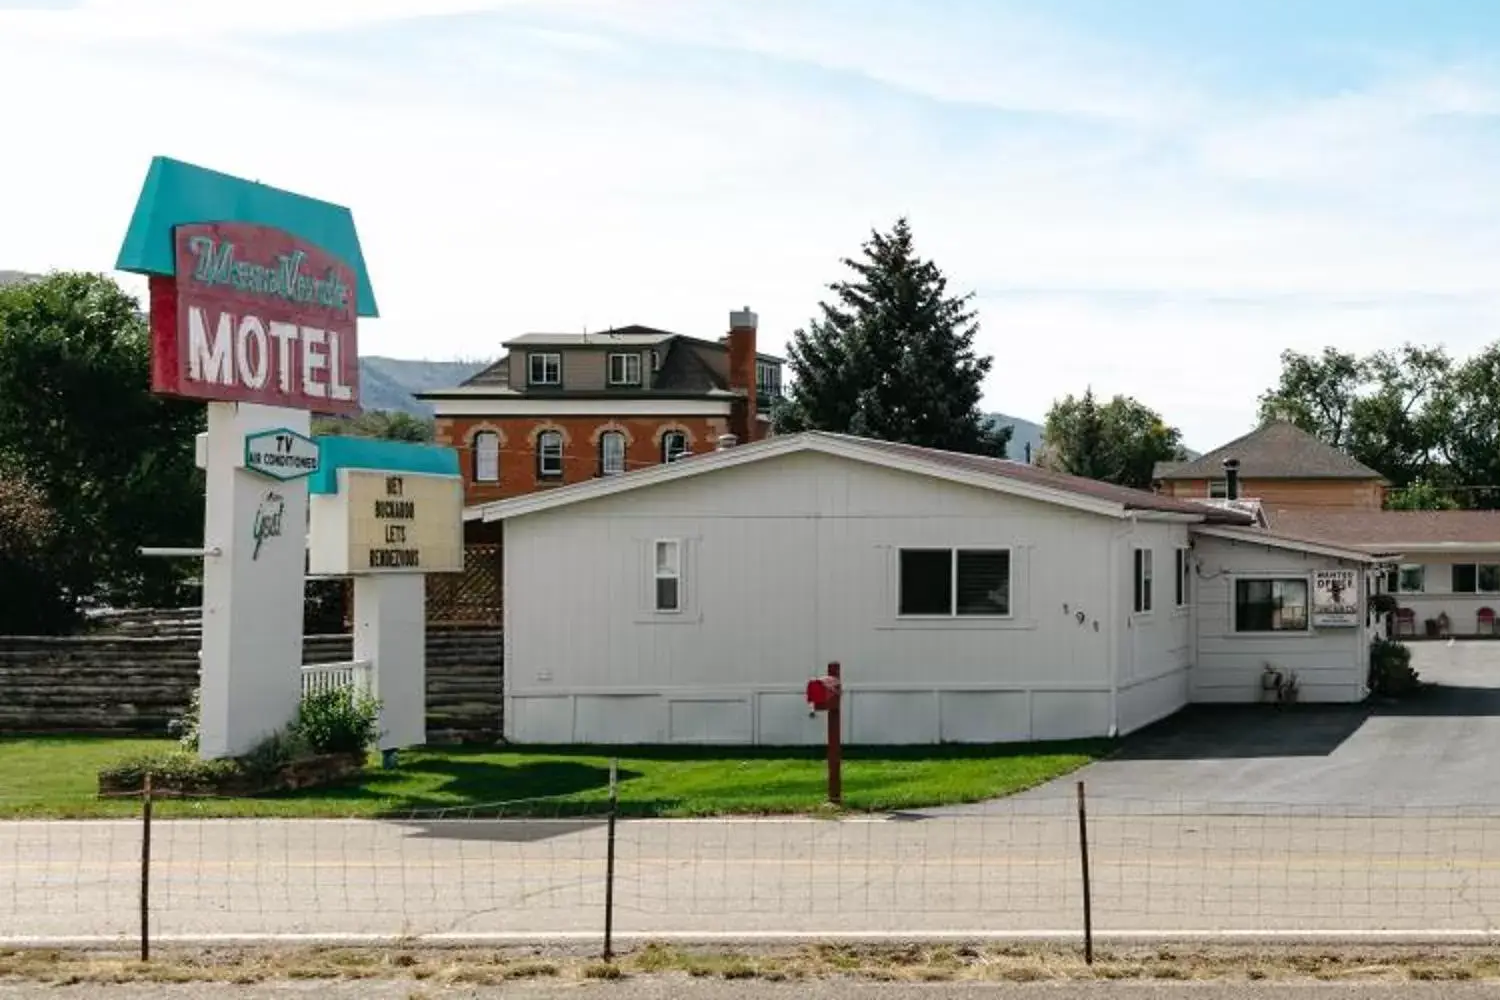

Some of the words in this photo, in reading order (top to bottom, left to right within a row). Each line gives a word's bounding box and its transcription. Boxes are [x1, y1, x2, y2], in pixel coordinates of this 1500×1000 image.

[187, 305, 352, 400] MOTEL
[276, 435, 294, 453] TV
[249, 452, 262, 465] AIR
[263, 453, 317, 469] CONDITIONED
[385, 476, 403, 495] HEY
[375, 500, 415, 519] BUCKAROO
[384, 525, 406, 543] LETS
[369, 549, 419, 568] RENDEZVOUS
